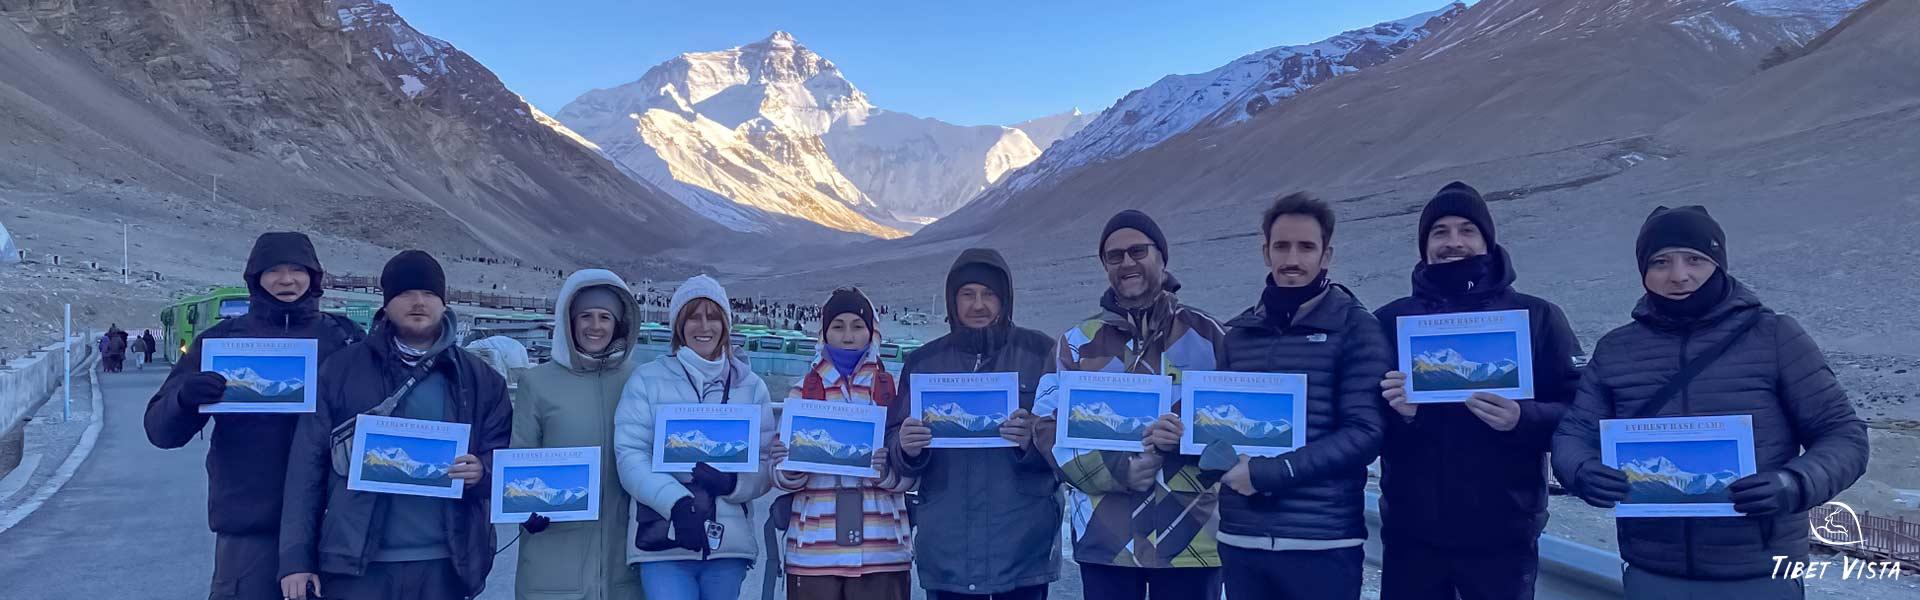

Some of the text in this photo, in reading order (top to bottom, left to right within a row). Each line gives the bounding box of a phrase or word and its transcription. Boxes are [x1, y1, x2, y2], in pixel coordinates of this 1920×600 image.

[928, 376, 960, 384] EVEREST
[1079, 375, 1111, 383] EVEREST
[1203, 375, 1238, 384] EVEREST
[1625, 423, 1666, 431] EVEREST
